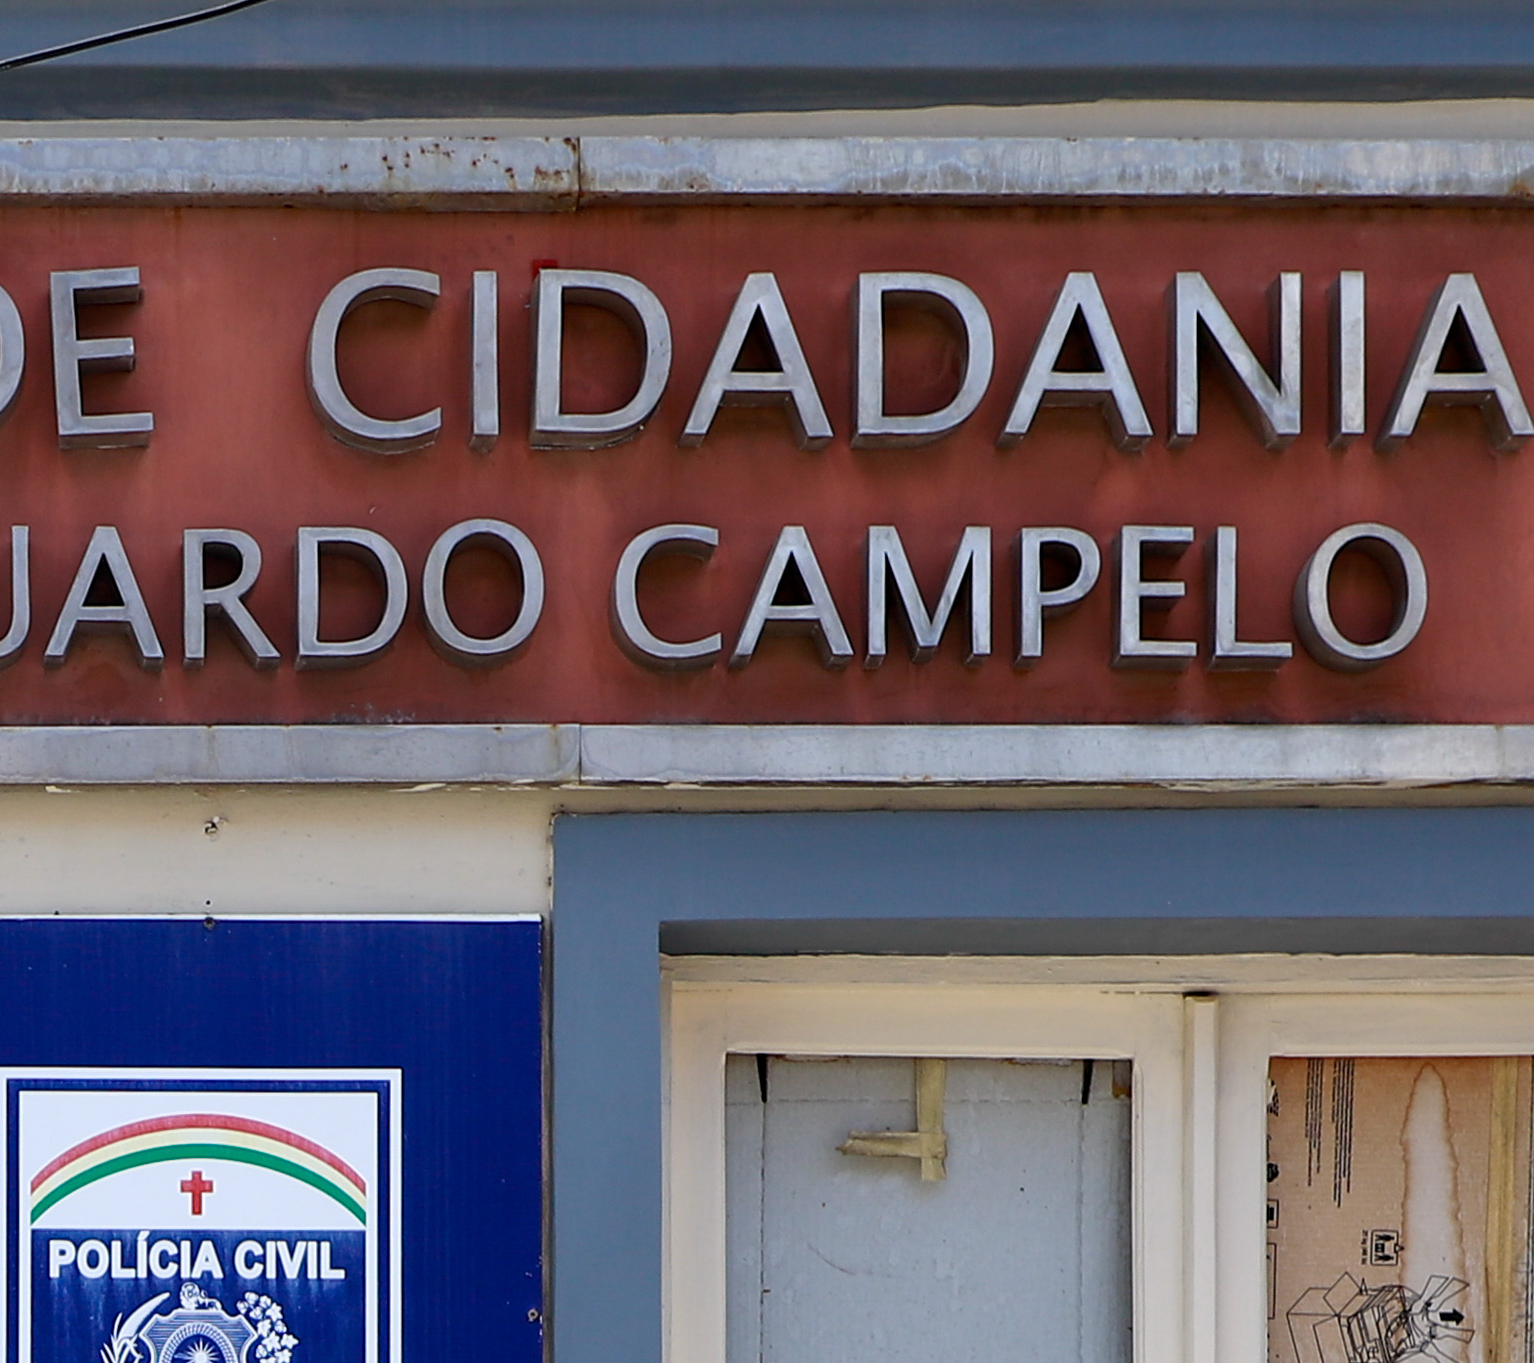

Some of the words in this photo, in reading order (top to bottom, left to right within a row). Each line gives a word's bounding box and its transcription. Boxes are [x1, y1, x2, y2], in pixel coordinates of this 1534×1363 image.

[612, 523, 1428, 673] CAMPELO
[50, 1231, 223, 1278] POLÍCIA
[235, 1241, 344, 1278] CIVIL
